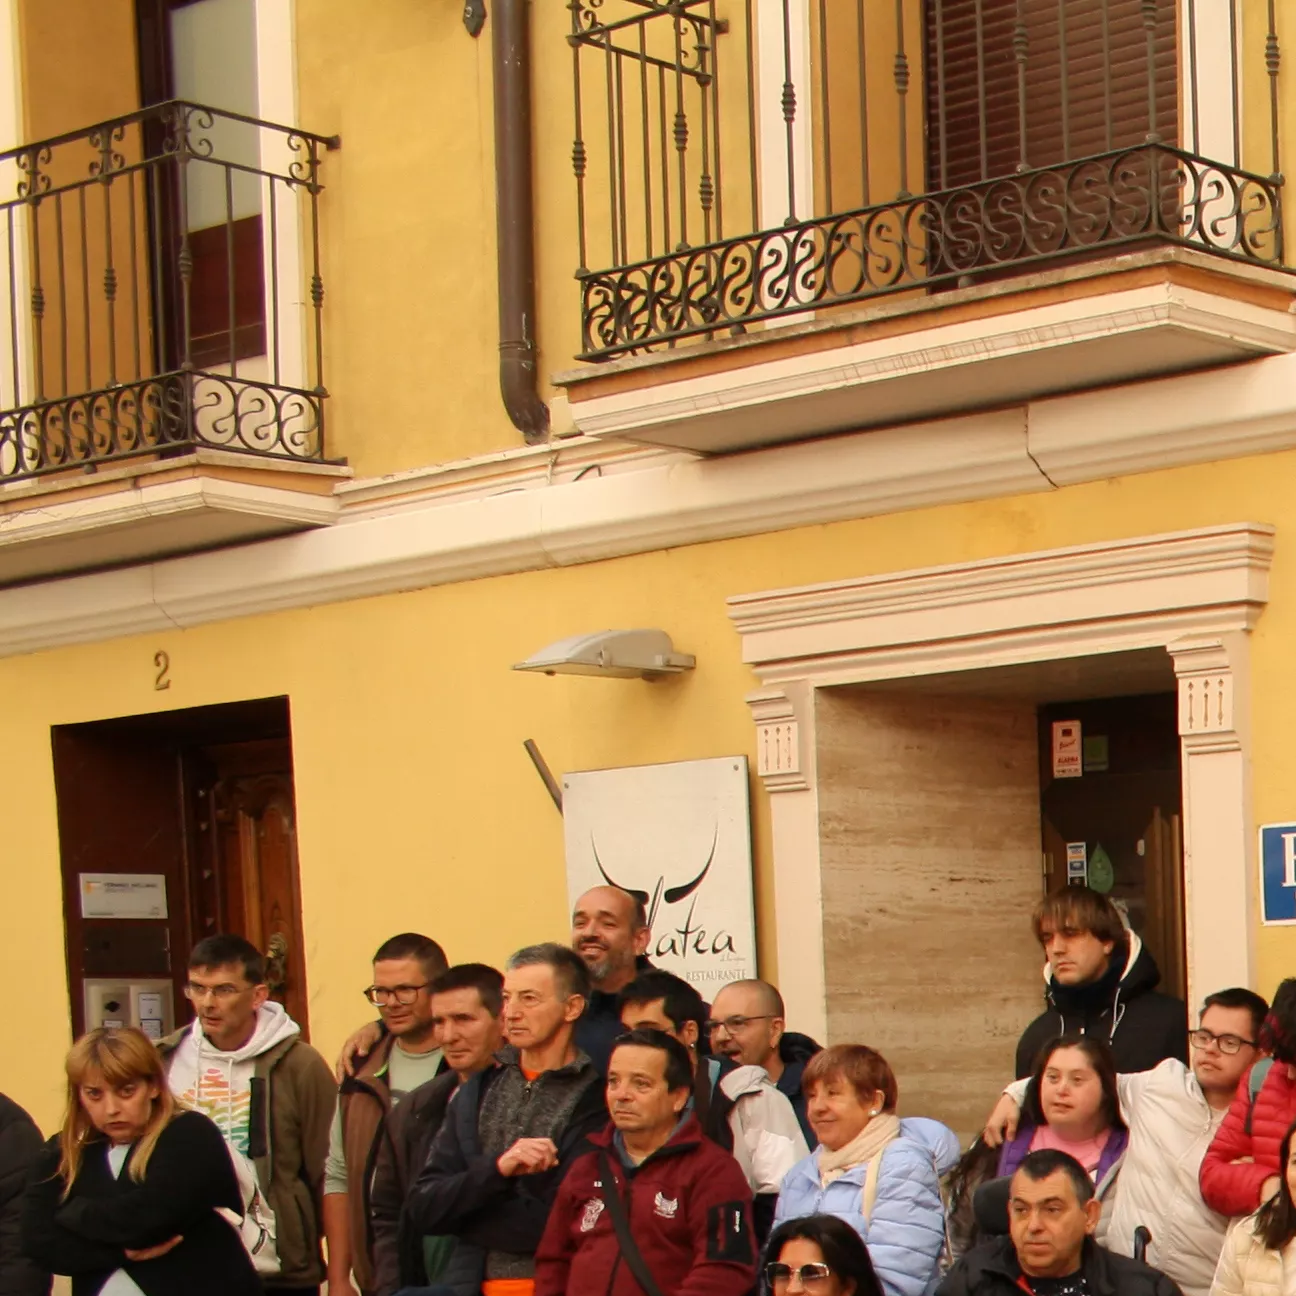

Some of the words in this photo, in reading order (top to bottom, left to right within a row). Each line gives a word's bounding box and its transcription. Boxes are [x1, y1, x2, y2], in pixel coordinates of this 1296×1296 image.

[154, 650, 171, 691] 2
[641, 875, 736, 959] latea
[685, 969, 747, 982] RESTAURANTE
